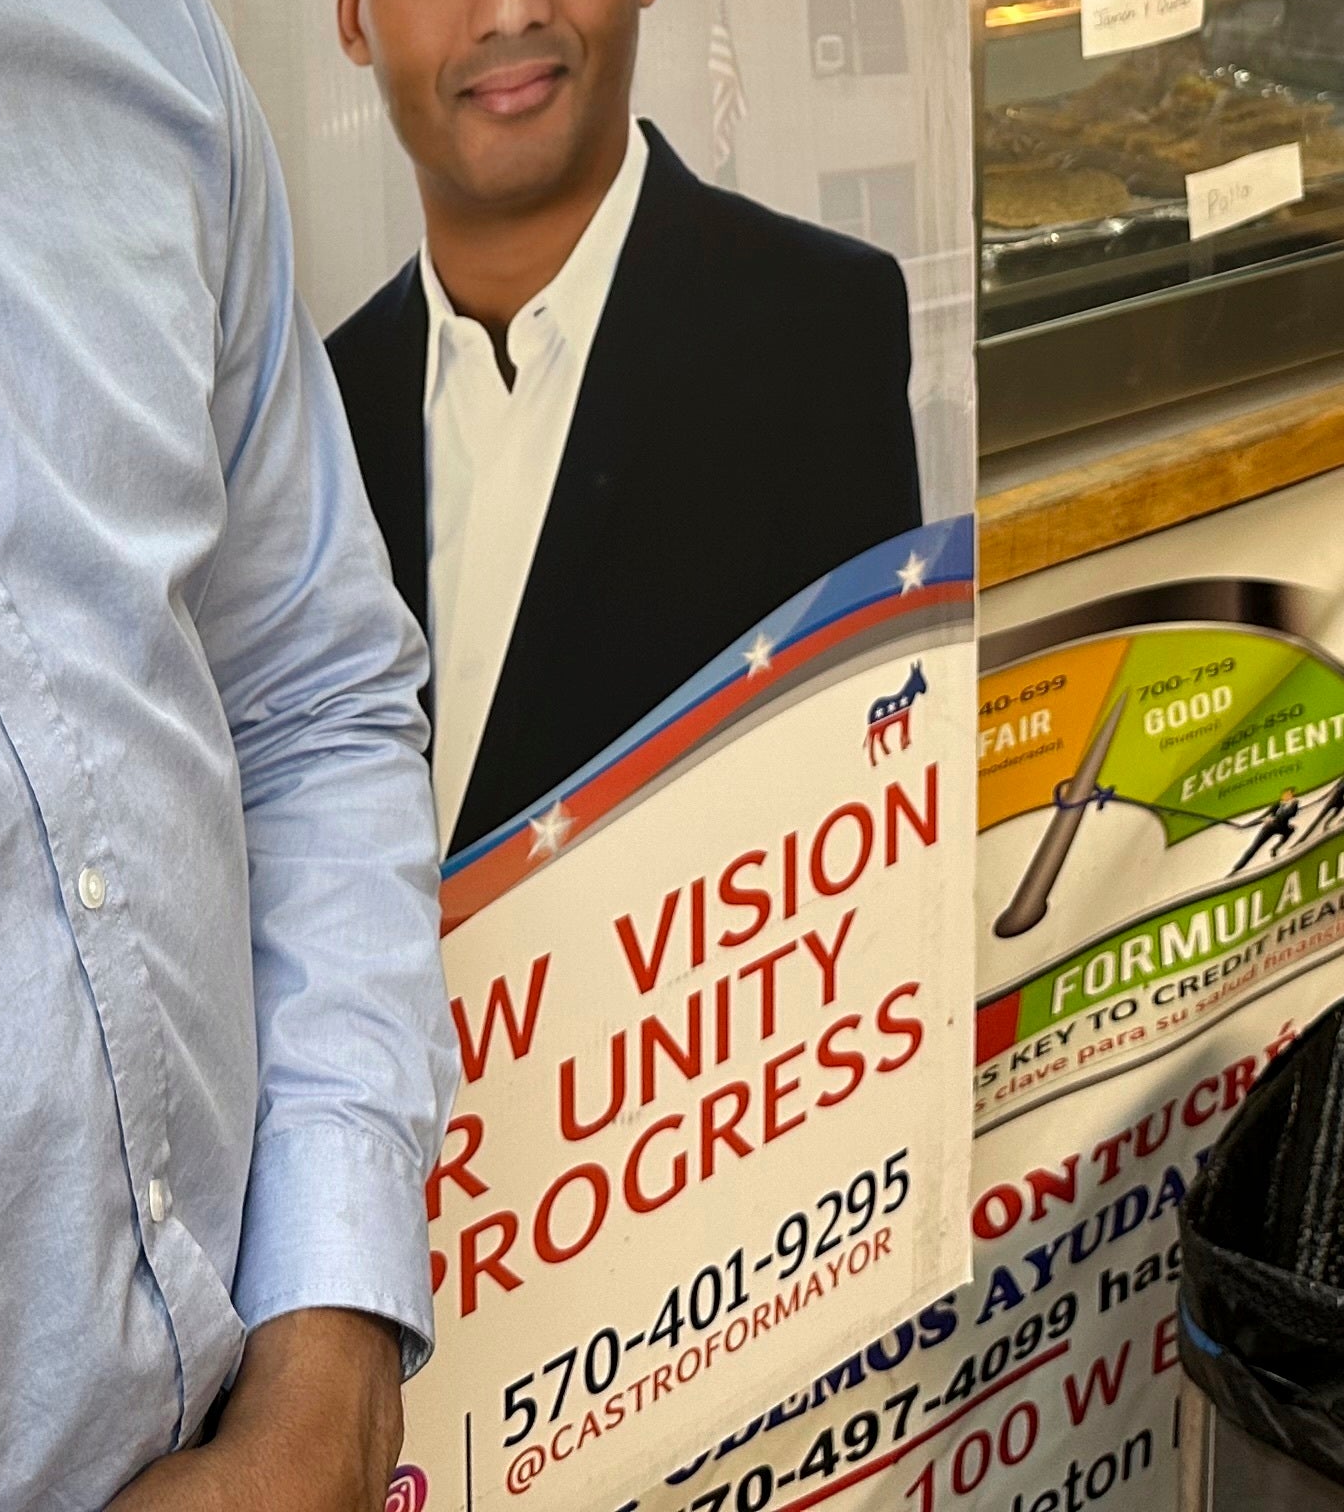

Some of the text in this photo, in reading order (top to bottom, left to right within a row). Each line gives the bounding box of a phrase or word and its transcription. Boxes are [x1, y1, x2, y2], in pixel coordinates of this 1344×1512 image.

[977, 708, 1051, 759] FAIR
[1137, 656, 1236, 703] 700-799
[1143, 685, 1233, 736] GOOD
[613, 761, 941, 995] VISION
[1050, 870, 1303, 1016] FORMULA
[559, 907, 859, 1143] UNITY
[994, 1055, 1069, 1100] clave
[1077, 1025, 1145, 1065] para
[1156, 1009, 1188, 1030] su
[1195, 964, 1258, 1011] salud
[1010, 1021, 1076, 1072] KEY
[1086, 998, 1138, 1032] TO
[1152, 931, 1271, 1006] CREDIT
[1092, 1098, 1176, 1186] TU
[501, 1146, 911, 1450] 570-401-9295
[975, 1149, 1215, 1326] AYUDA
[506, 1226, 894, 1496] @CASTROFORMAYOR
[678, 1290, 1079, 1512] 70-497-4099
[904, 1400, 1040, 1512] 100
